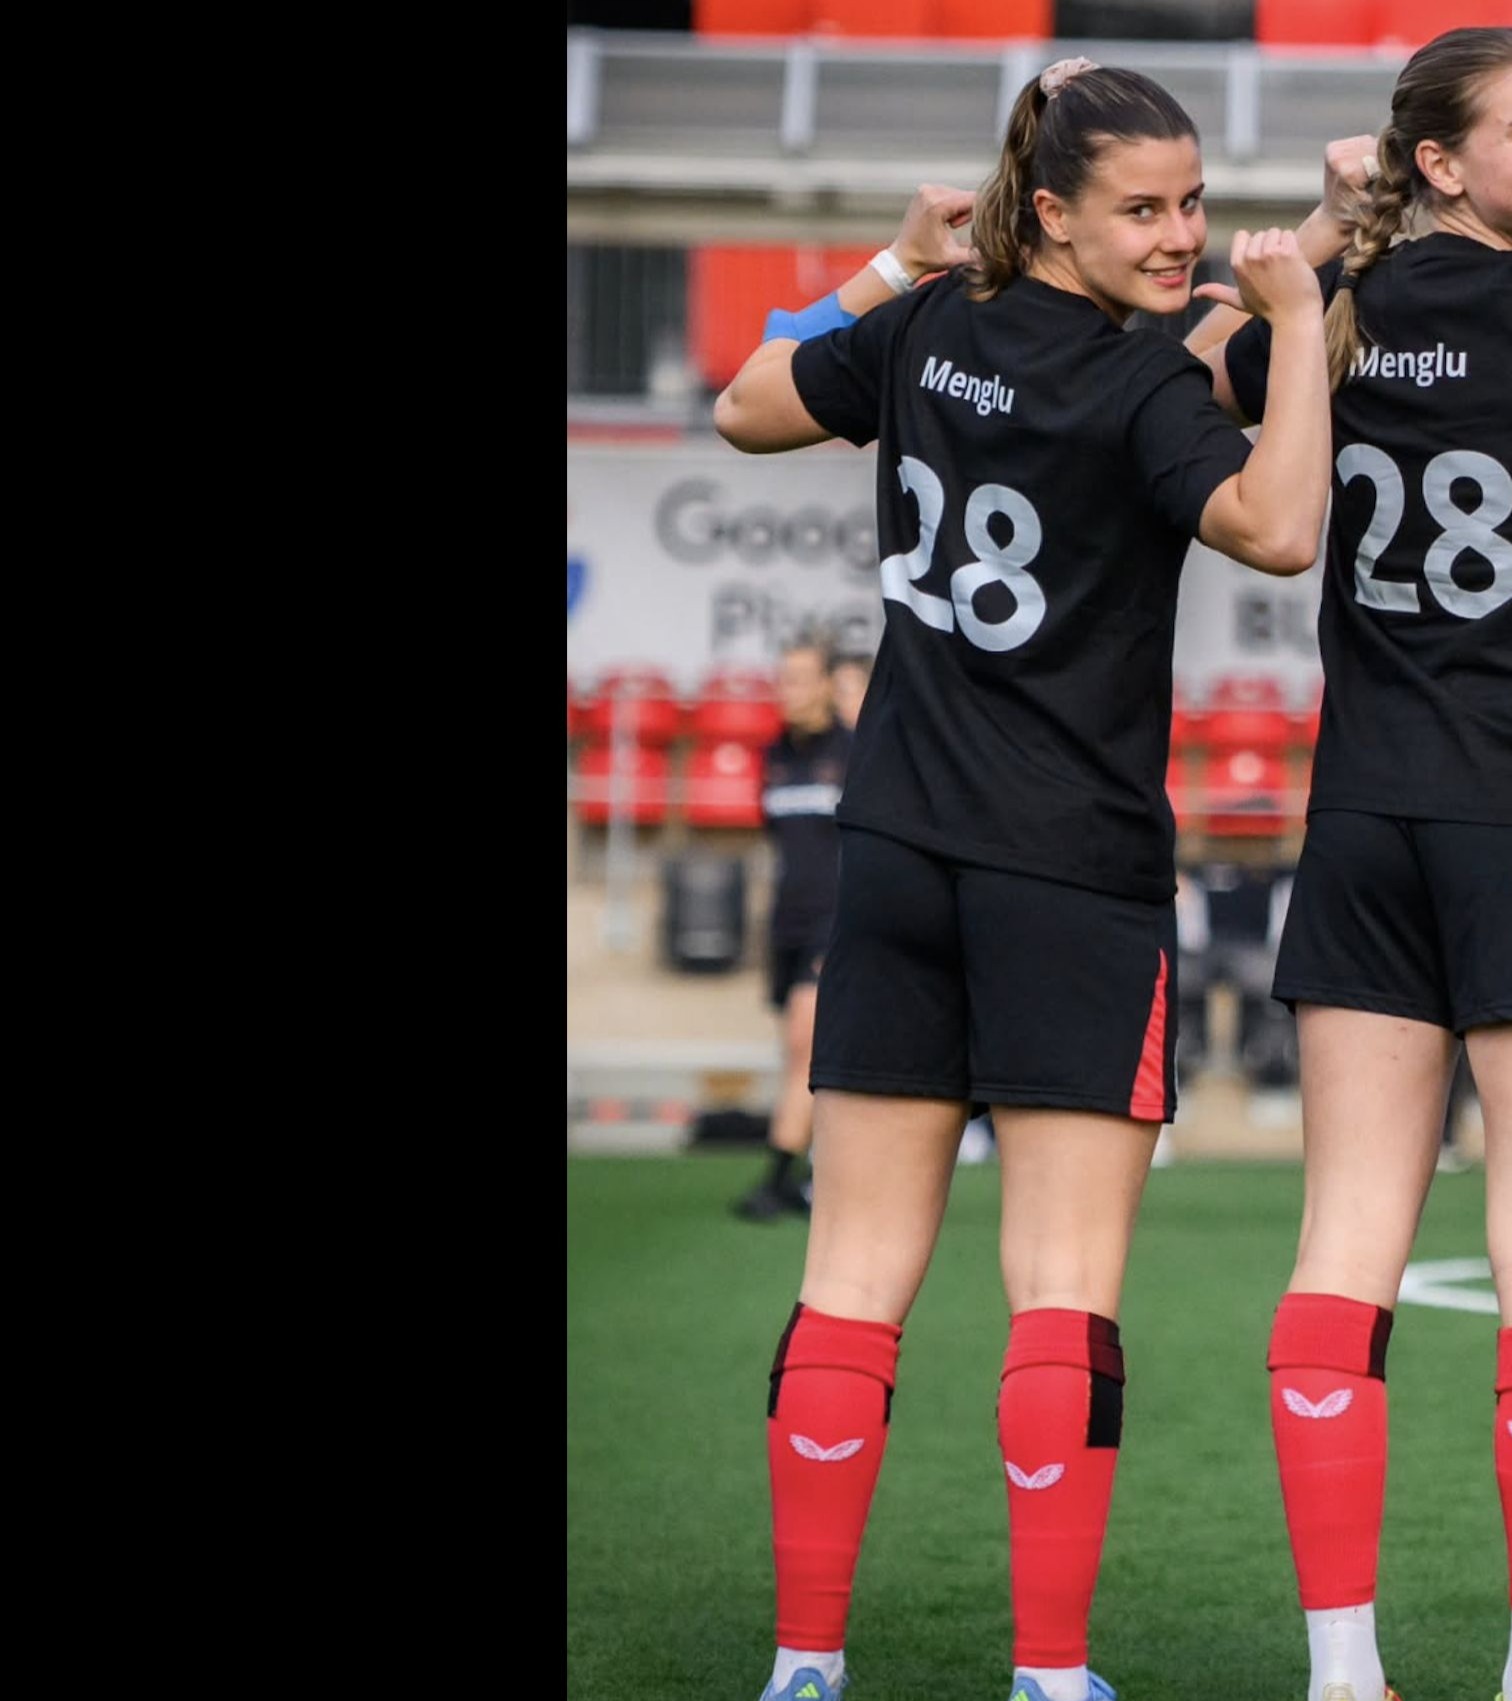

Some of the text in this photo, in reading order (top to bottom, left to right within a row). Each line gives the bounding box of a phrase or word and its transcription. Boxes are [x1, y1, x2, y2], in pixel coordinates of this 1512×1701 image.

[920, 356, 1015, 416] Menglu
[1350, 342, 1467, 387] Menglu
[879, 455, 1047, 653] 28
